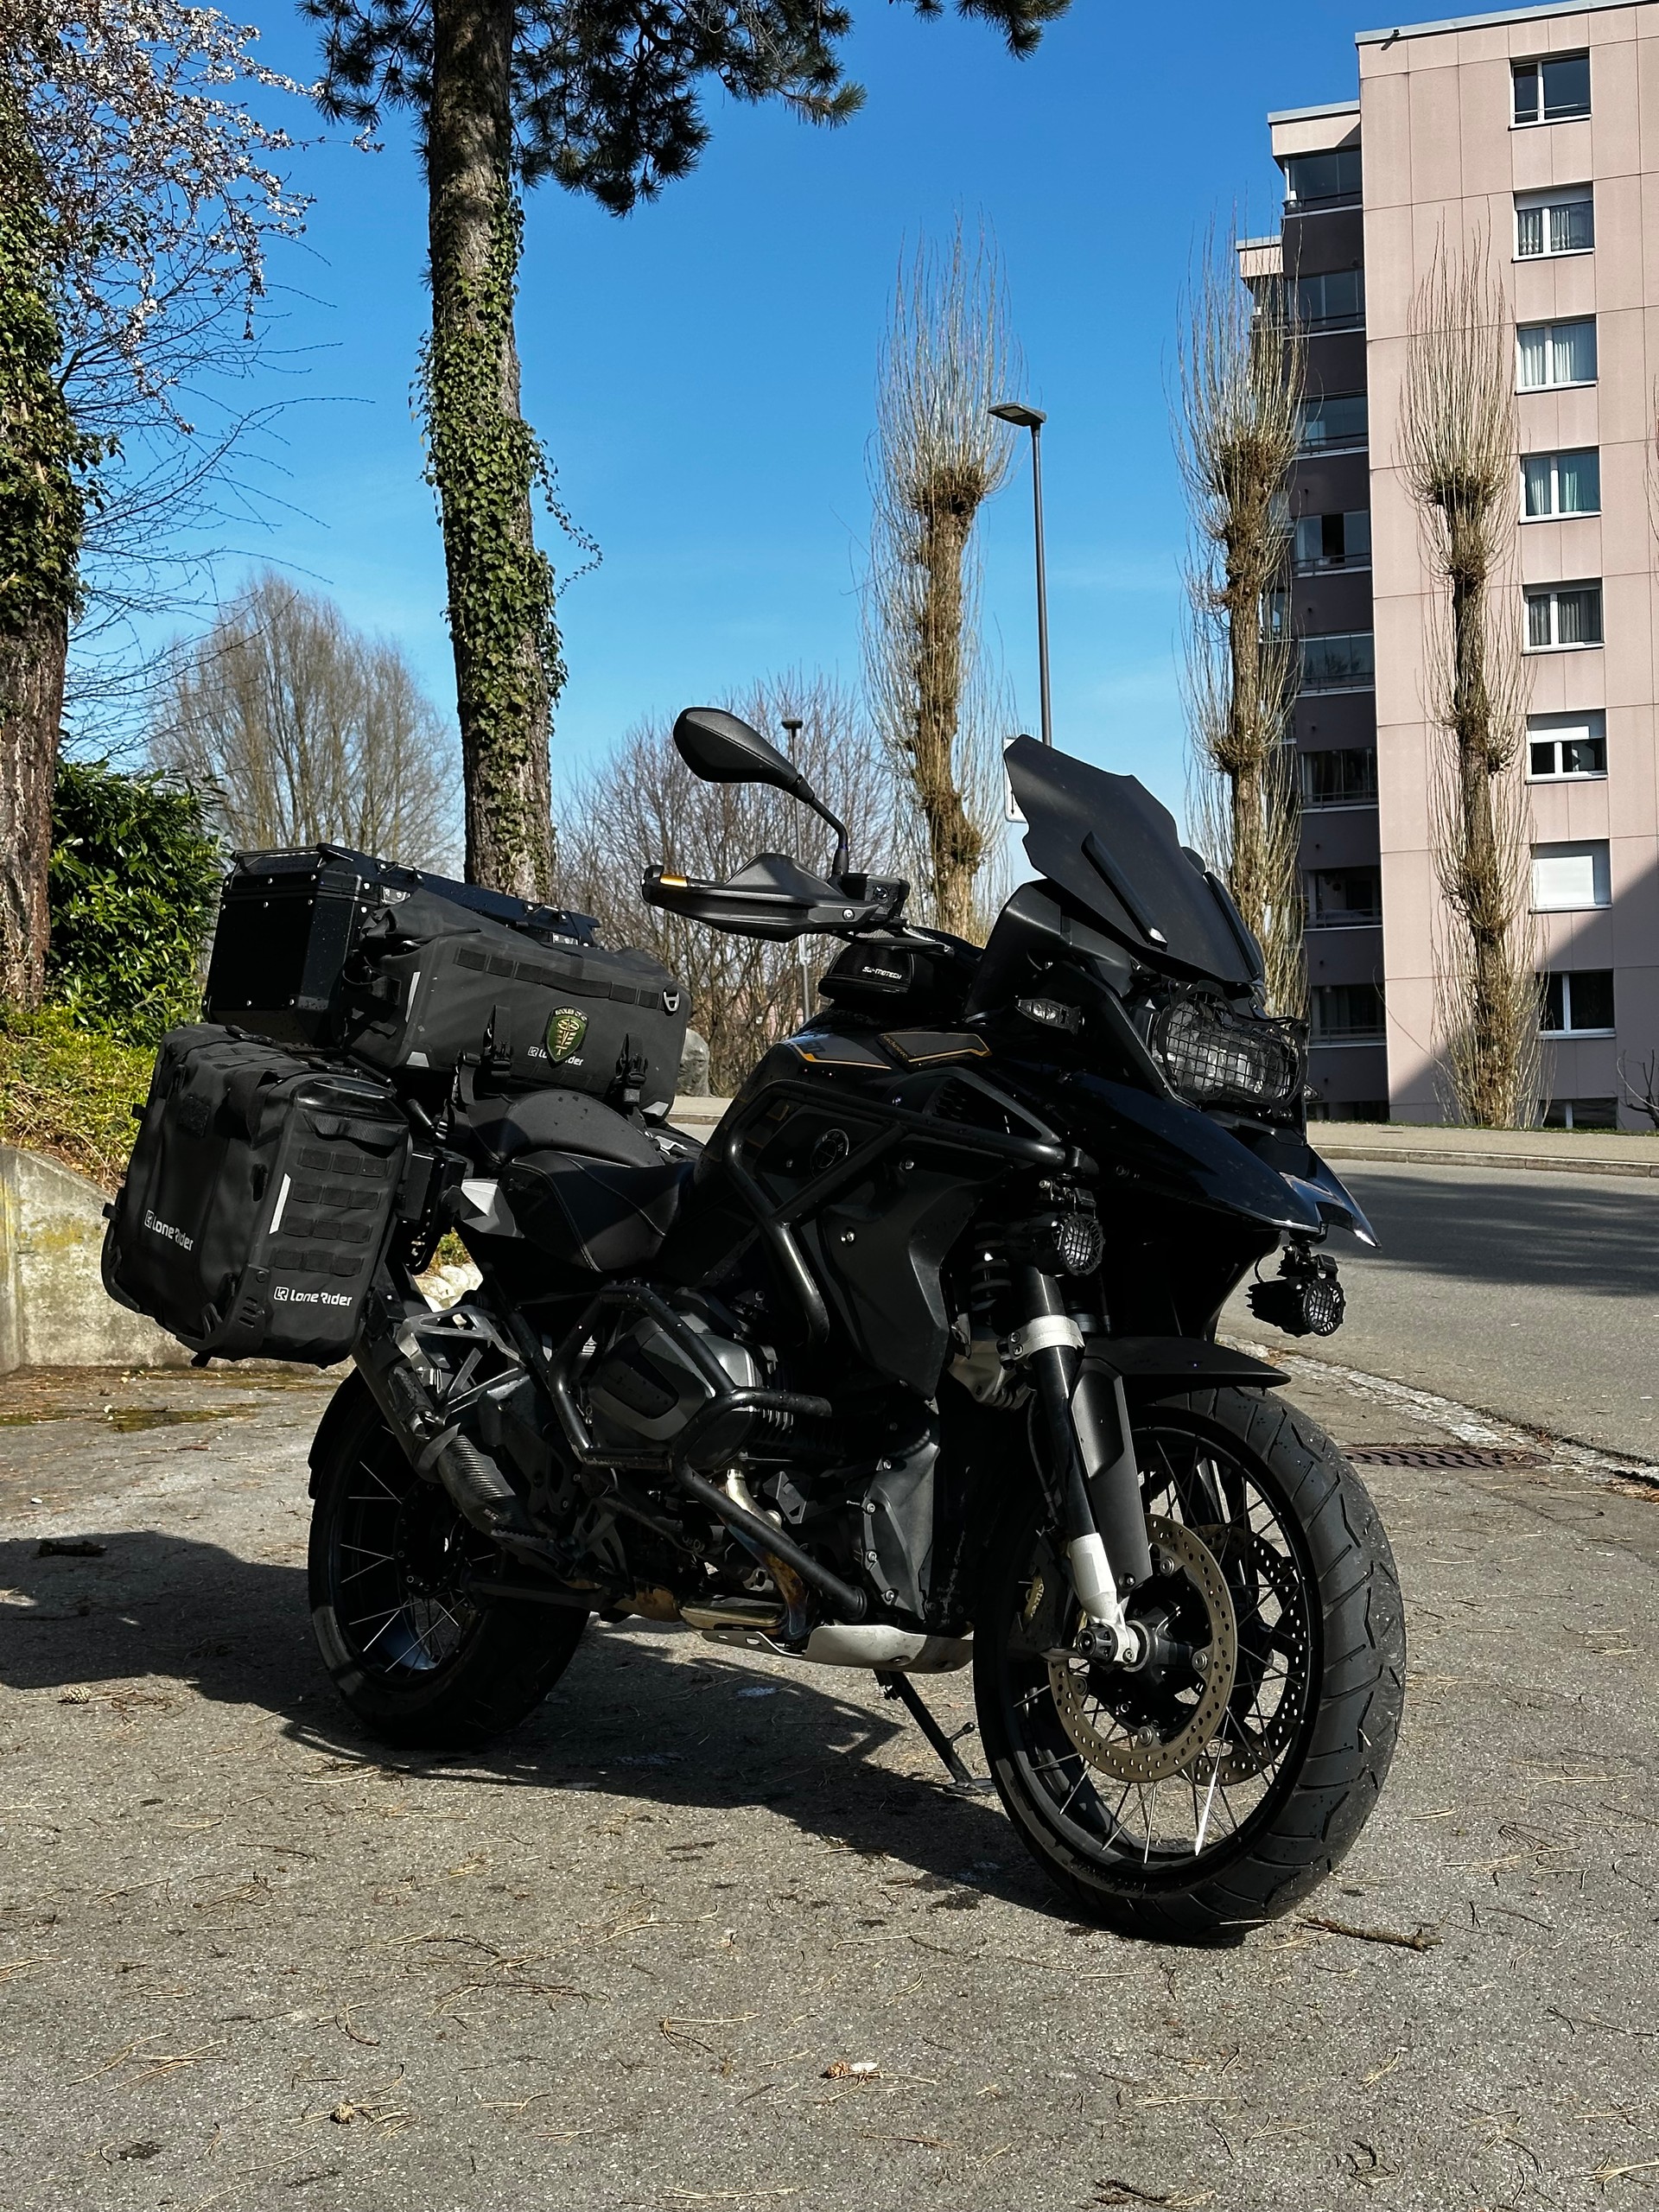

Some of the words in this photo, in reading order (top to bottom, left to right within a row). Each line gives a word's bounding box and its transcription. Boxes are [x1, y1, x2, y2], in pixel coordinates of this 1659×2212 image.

[862, 966, 902, 980] SW-MOTECH
[152, 1216, 175, 1240] Lone
[289, 1289, 320, 1303] Lone
[320, 1292, 353, 1306] Rider
